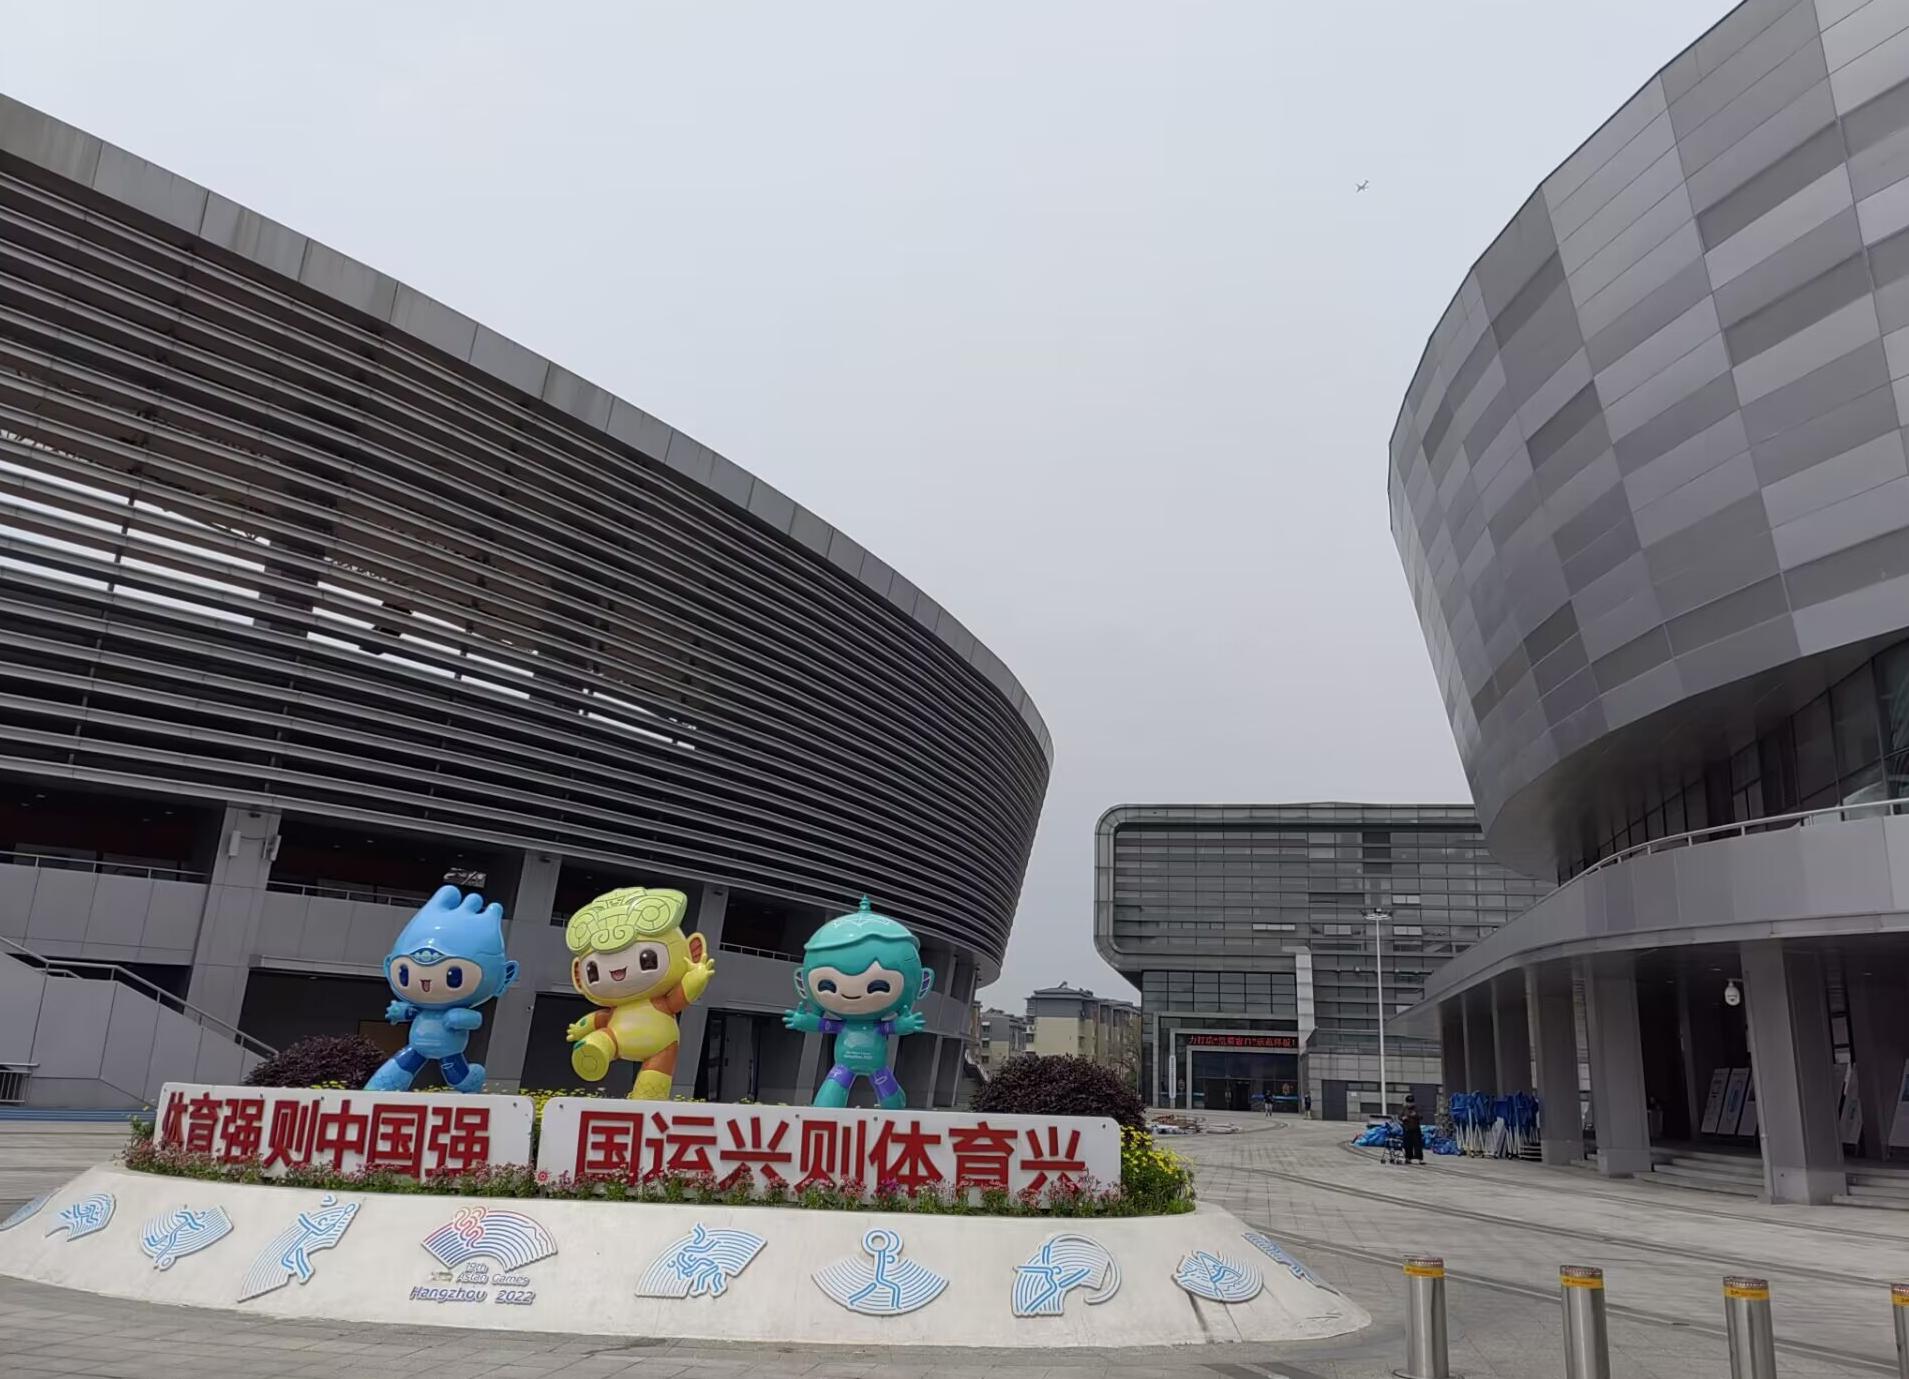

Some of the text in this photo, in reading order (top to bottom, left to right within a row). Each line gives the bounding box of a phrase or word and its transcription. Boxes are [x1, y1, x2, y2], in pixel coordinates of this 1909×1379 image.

[161, 1091, 491, 1180] 体育强则中国强
[573, 1109, 1087, 1198] 国运兴则体育兴
[409, 1286, 536, 1305] Hangzhou 2022
[456, 1272, 530, 1287] Asian Games
